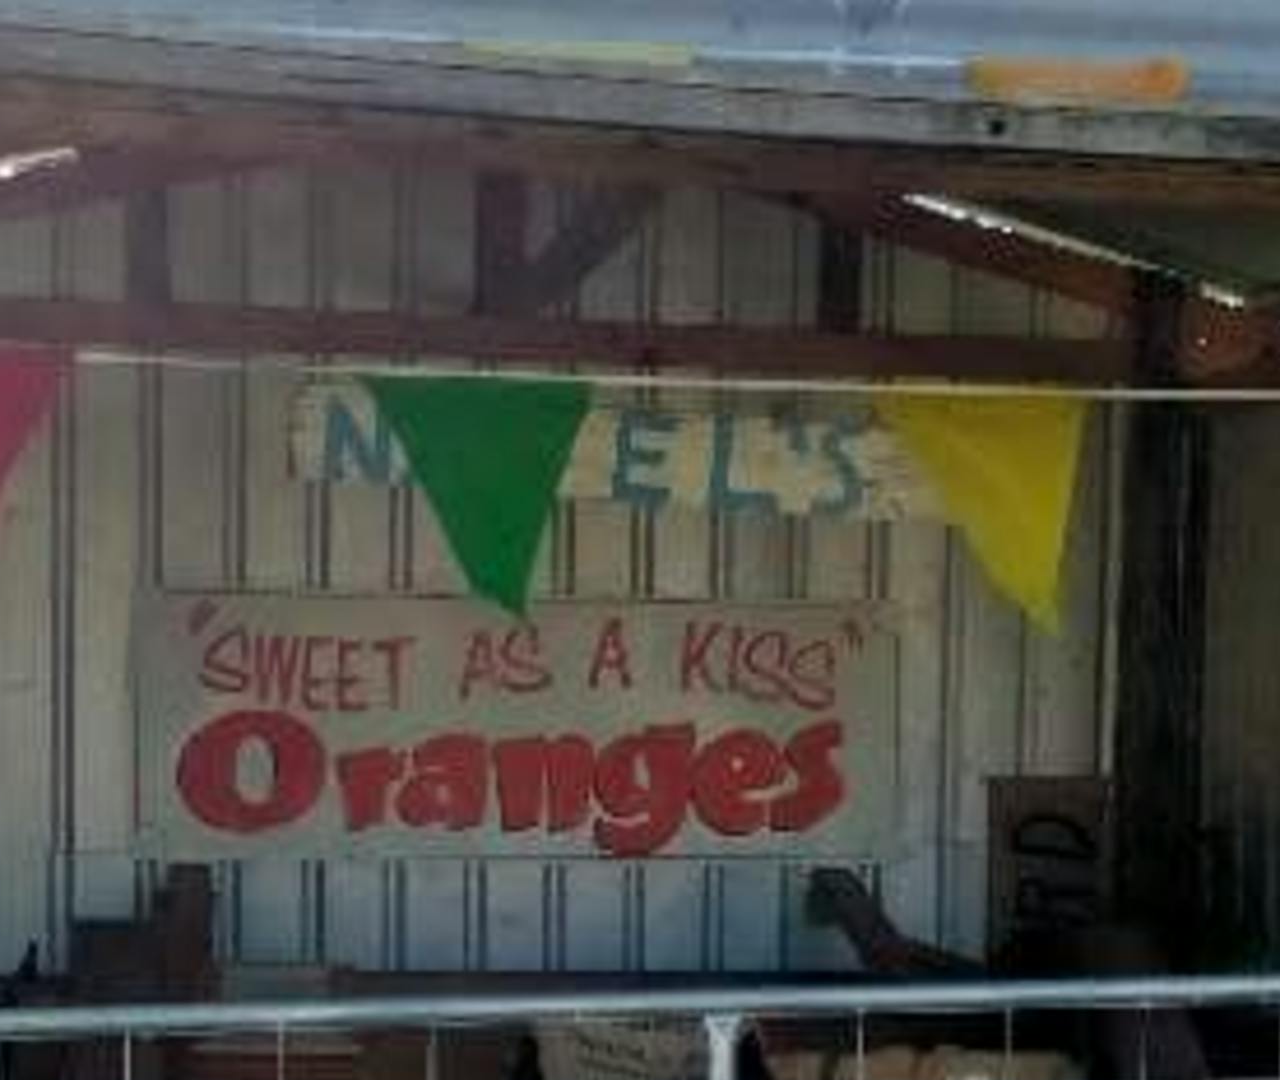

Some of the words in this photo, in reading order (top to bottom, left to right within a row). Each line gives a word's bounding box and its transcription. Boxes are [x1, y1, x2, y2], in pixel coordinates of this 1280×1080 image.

[188, 603, 417, 711] "SWEET
[458, 622, 554, 697] AS
[587, 616, 634, 692] A
[678, 614, 865, 711] KISS"
[175, 708, 847, 857] Oranges
